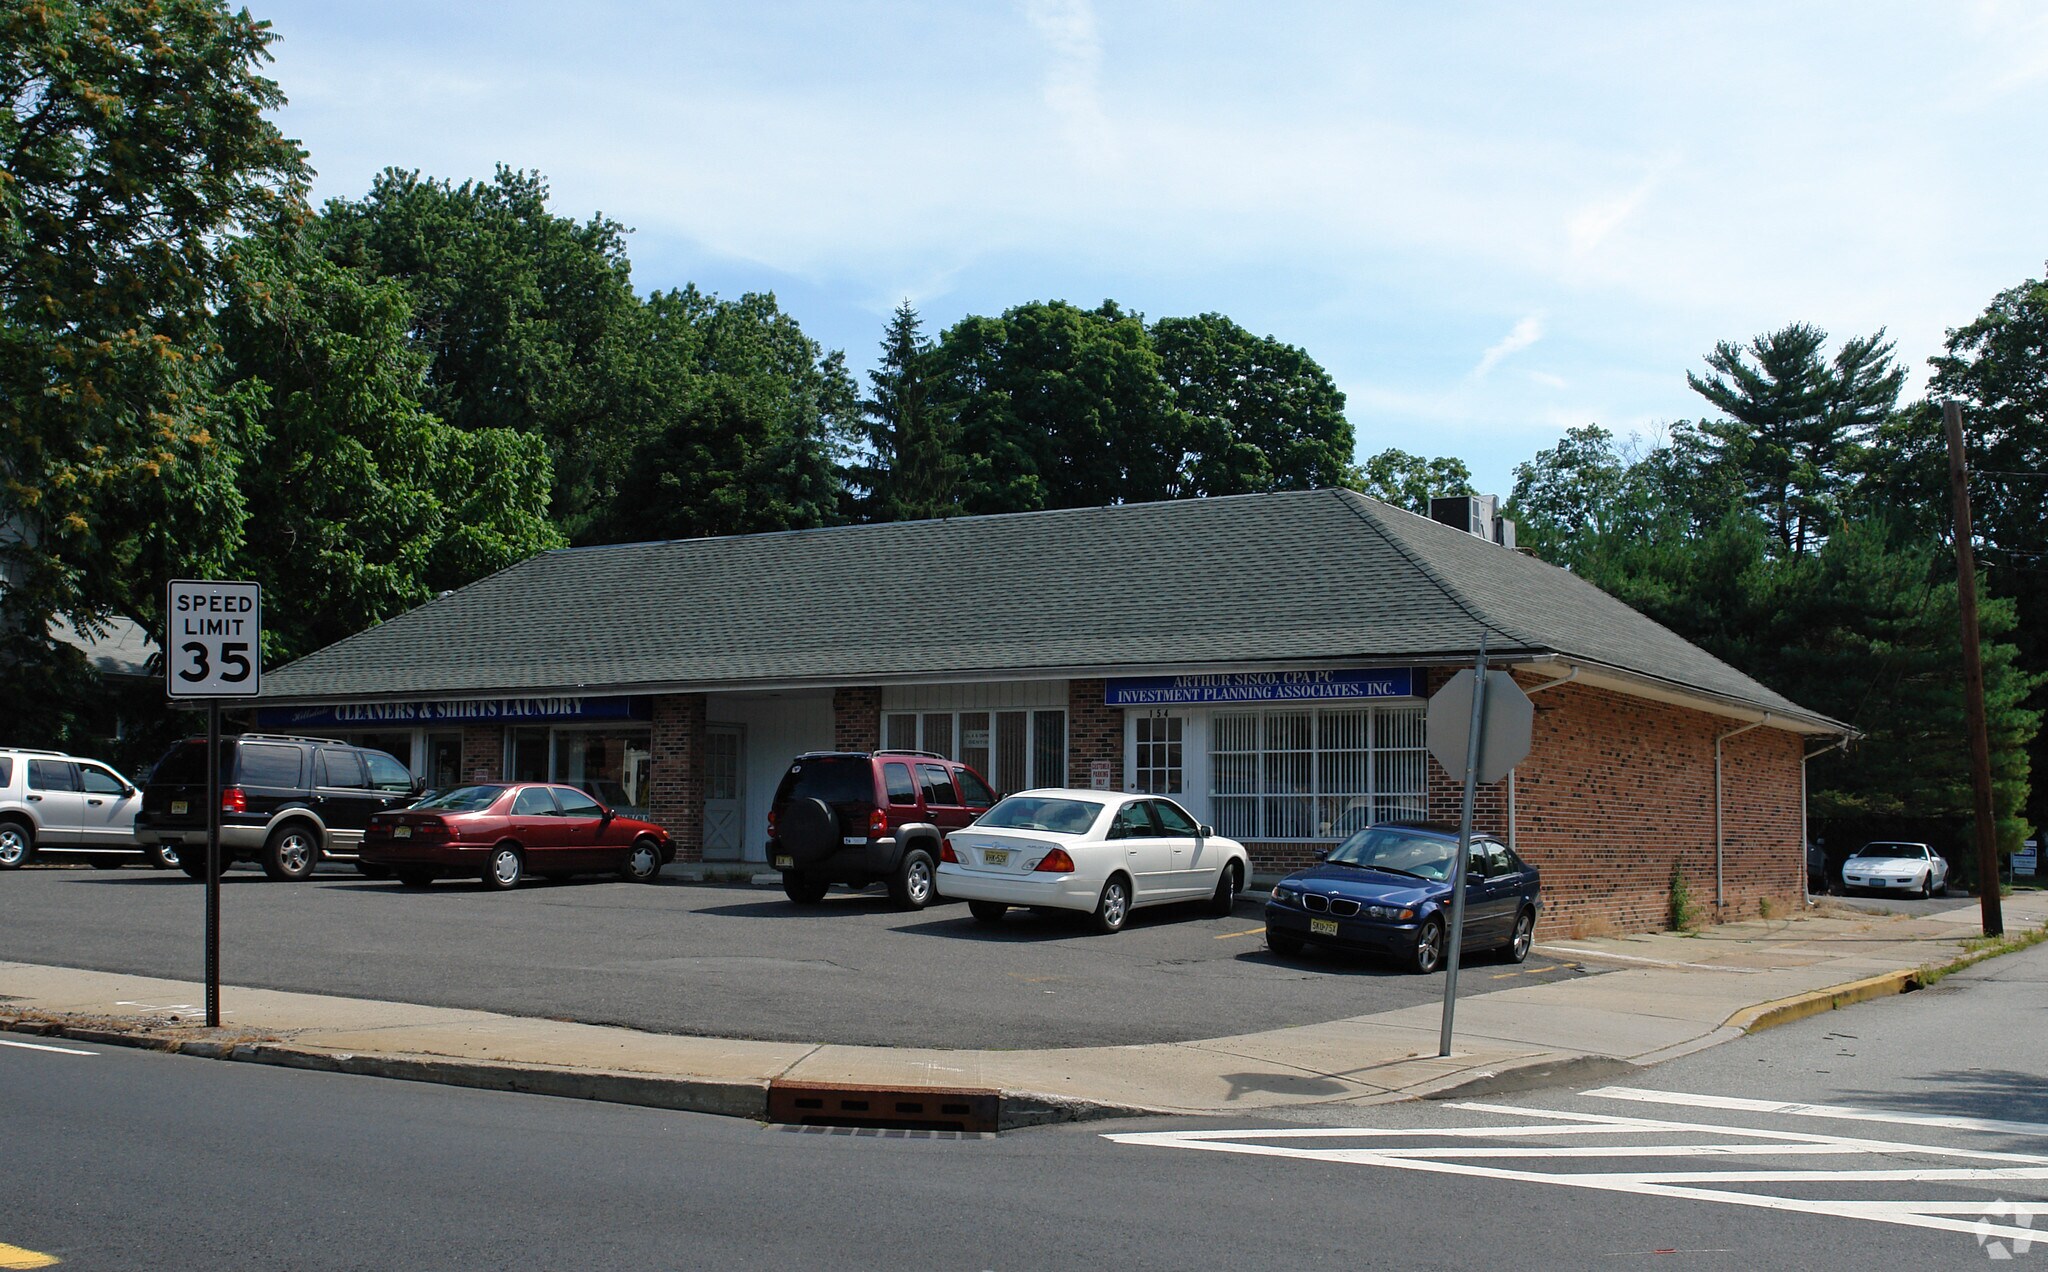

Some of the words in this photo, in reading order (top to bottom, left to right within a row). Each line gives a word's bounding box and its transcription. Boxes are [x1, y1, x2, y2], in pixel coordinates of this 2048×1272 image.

[177, 595, 252, 612] SPEED
[184, 618, 244, 635] LIMIT
[178, 641, 251, 682] 35
[1173, 674, 1231, 687] ARTHUR
[1234, 672, 1280, 686] SISCO,
[1283, 671, 1311, 684] CPA
[1315, 670, 1334, 683] PC
[1117, 688, 1200, 703] INVESTMENT
[1203, 686, 1272, 700] PLANNING
[1275, 683, 1364, 699] ASSOCIATES,
[1367, 682, 1396, 696] INC.
[334, 702, 415, 721] CLEANERS
[418, 701, 432, 719] &
[436, 700, 497, 718] SHIRTS
[501, 697, 583, 716] LAUNDRY
[1149, 709, 1168, 718] 154
[1092, 770, 1109, 778] PARKING
